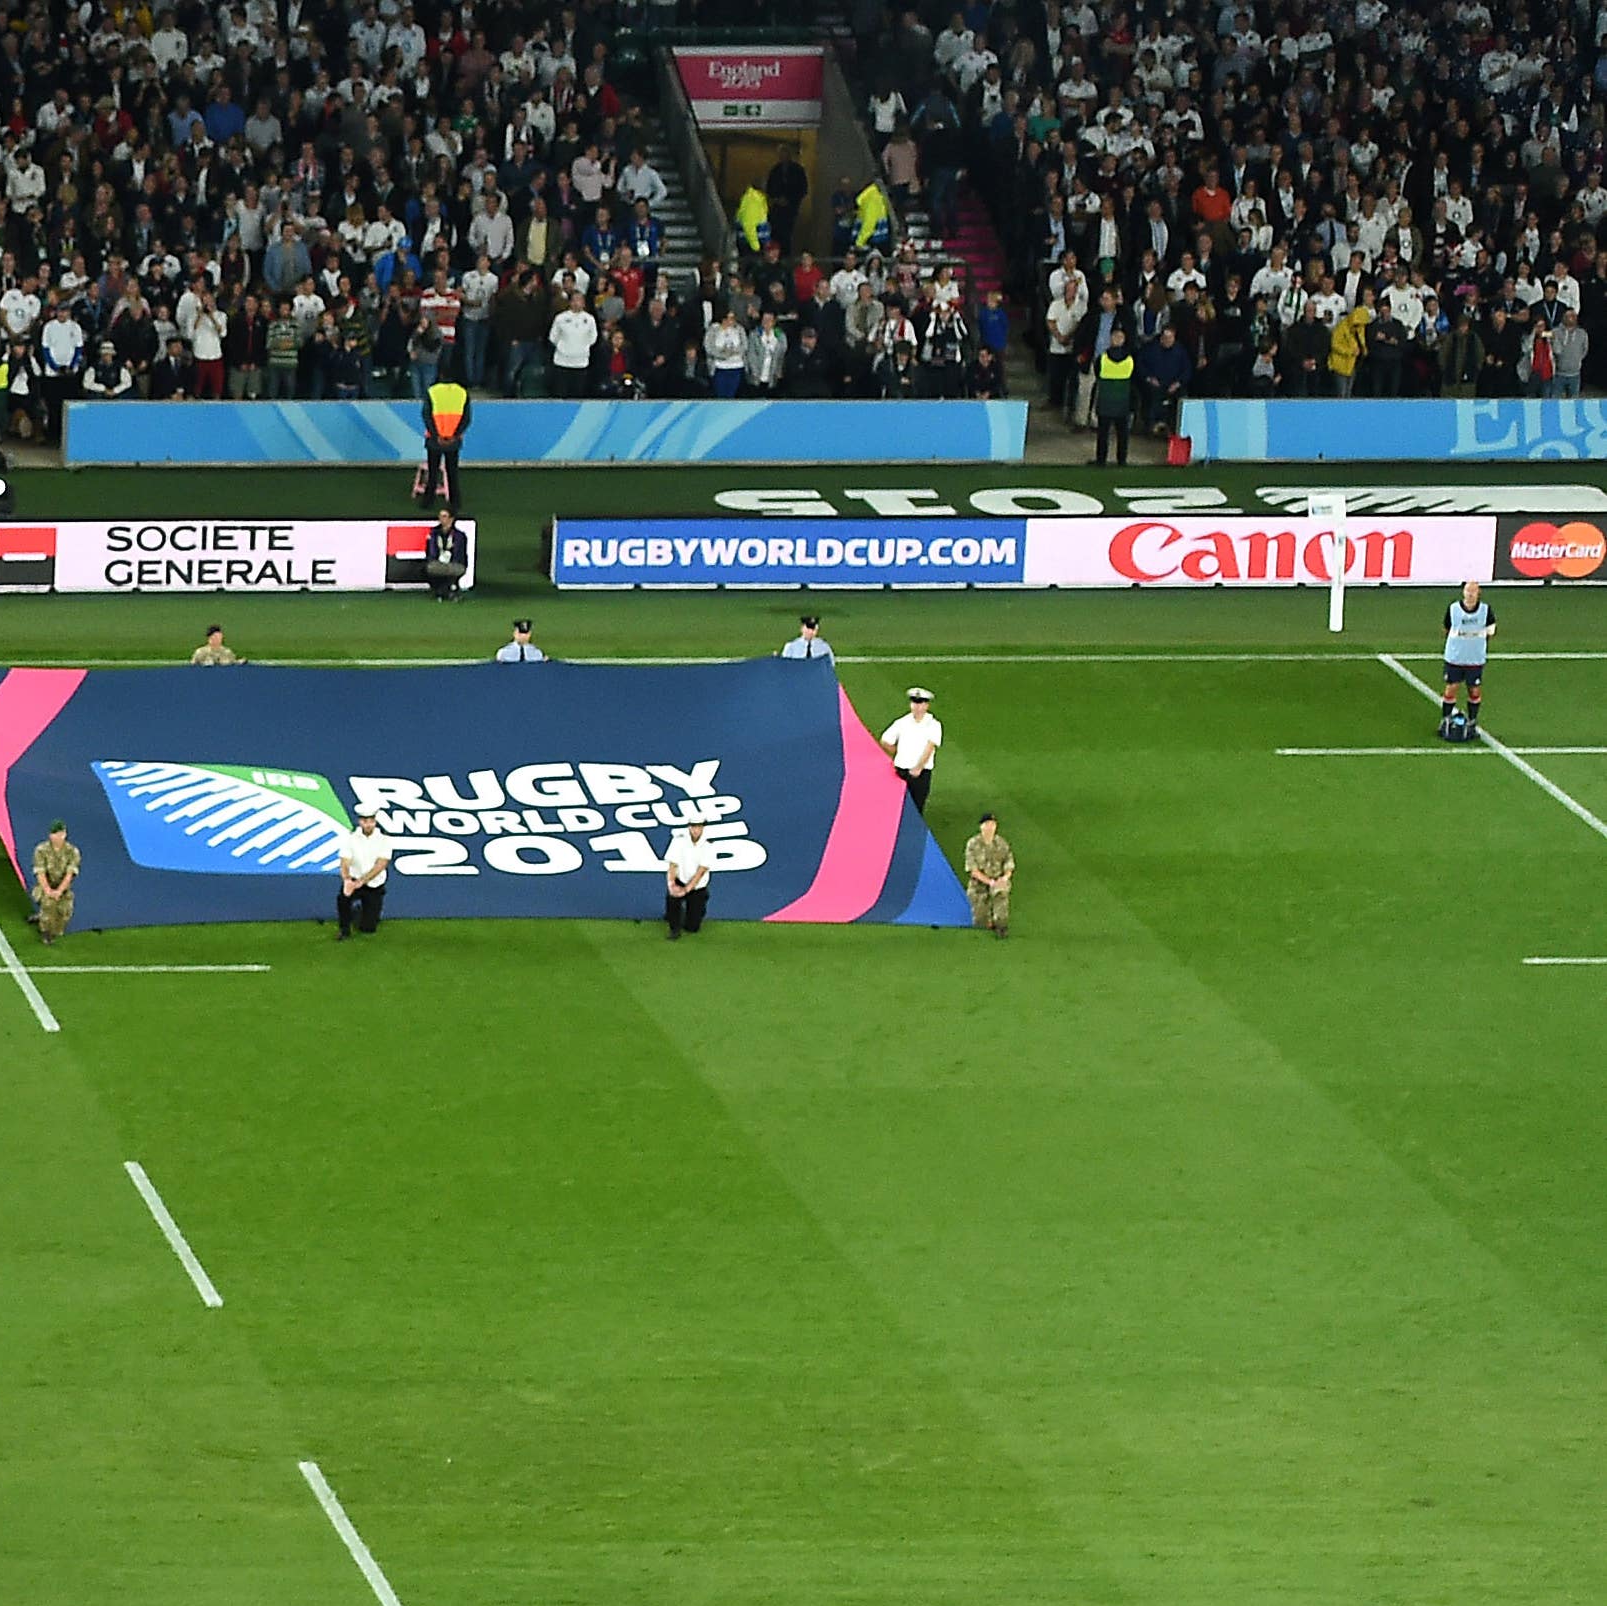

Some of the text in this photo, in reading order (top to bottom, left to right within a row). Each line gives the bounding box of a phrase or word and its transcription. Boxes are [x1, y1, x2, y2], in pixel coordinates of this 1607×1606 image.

[106, 525, 294, 551] SOCIETE
[562, 537, 1018, 567] RUGBYWORLDCUP.COM
[1108, 522, 1414, 582] Canon
[1509, 541, 1603, 560] MasterCard
[104, 559, 337, 585] GENERALE
[251, 771, 320, 791] IRB
[348, 759, 721, 811] RUGBY
[373, 795, 743, 836] WORLD CUP
[389, 821, 769, 876] 2015
